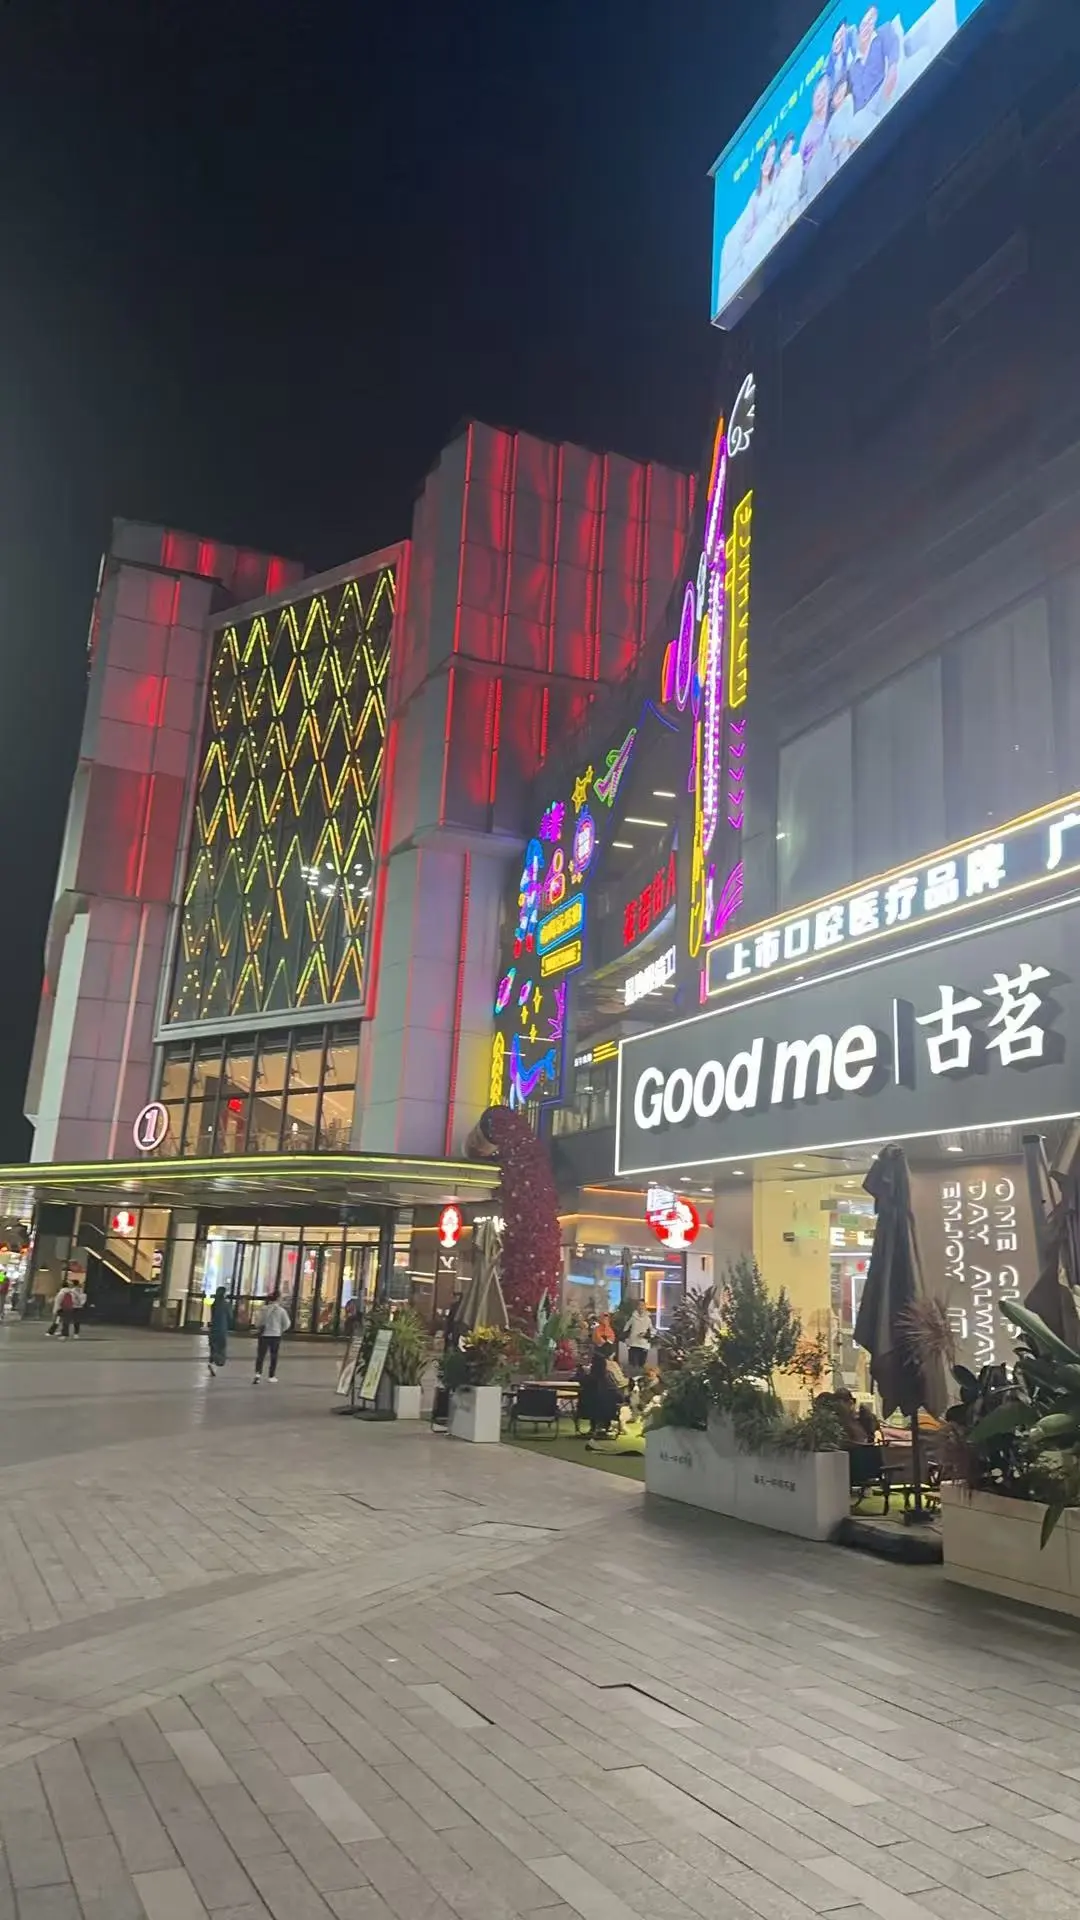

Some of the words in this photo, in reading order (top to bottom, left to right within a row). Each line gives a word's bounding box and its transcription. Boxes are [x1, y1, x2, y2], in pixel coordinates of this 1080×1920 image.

[726, 842, 1006, 981] 上市口腔医疗品牌
[915, 962, 1051, 1075] 古茗
[942, 1182, 965, 1283] ENJOY
[967, 1179, 990, 1245] DAY
[995, 1177, 1018, 1251] ONE
[946, 1307, 968, 1339] IT
